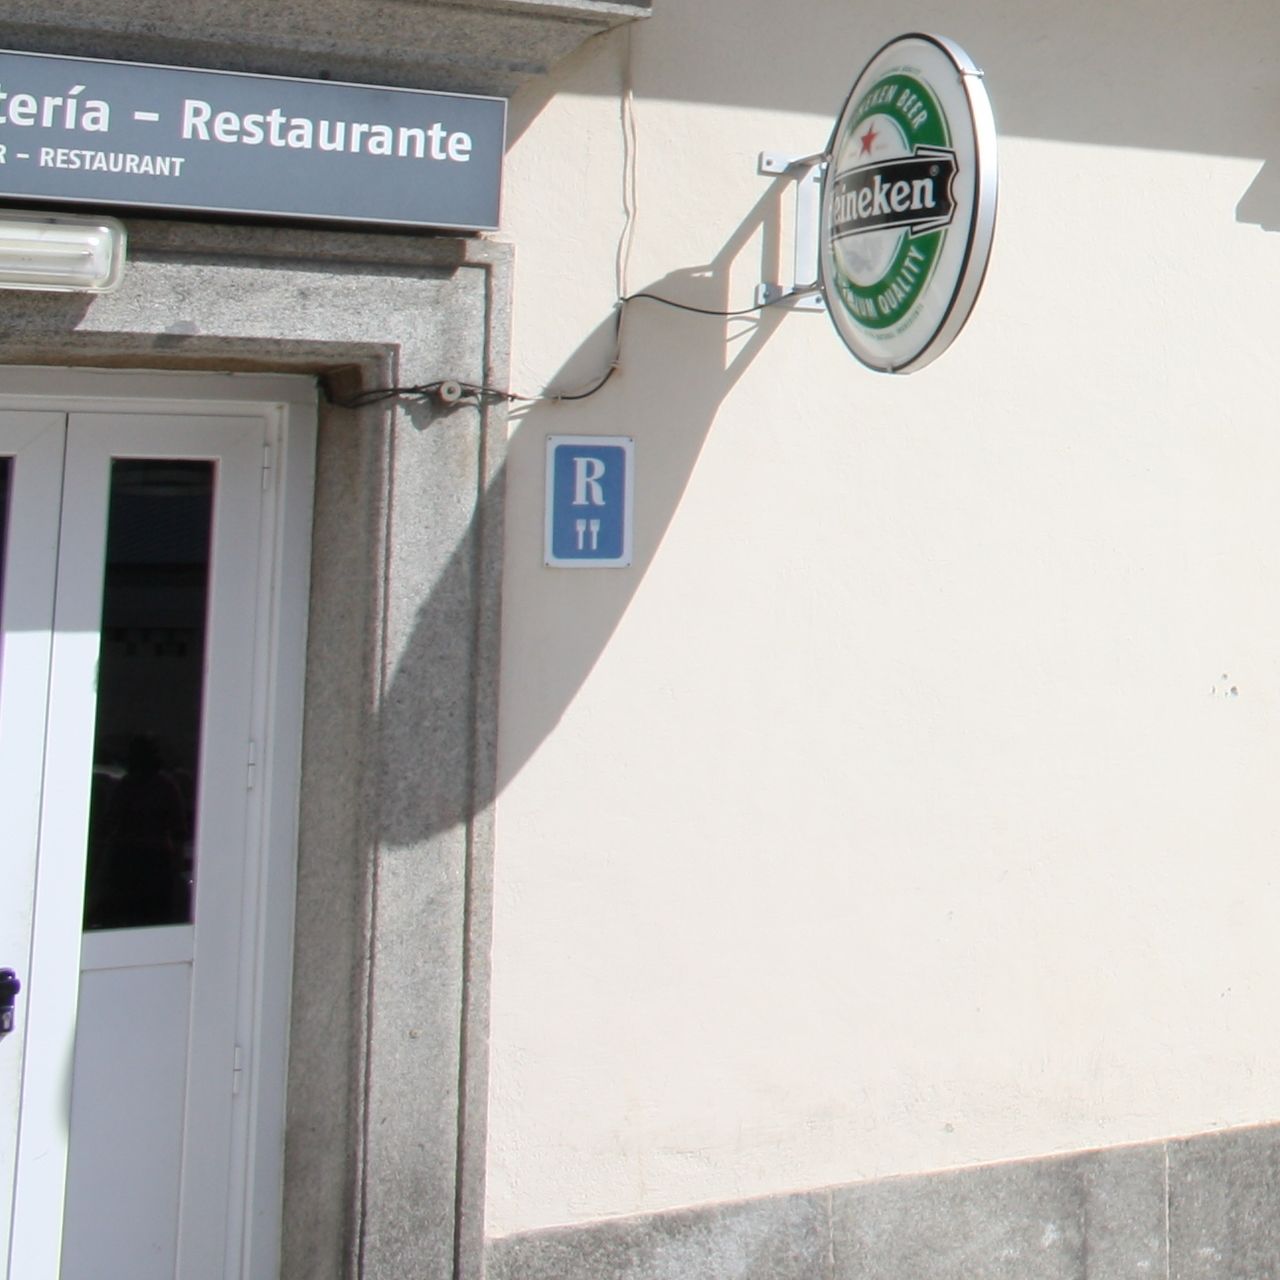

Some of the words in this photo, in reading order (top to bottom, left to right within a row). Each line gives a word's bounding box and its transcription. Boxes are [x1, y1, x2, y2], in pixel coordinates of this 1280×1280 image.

[181, 99, 473, 162] Restaurante
[896, 88, 928, 129] BEER
[39, 147, 185, 177] RESTAURANT
[878, 245, 925, 314] QUALITY
[572, 457, 606, 506] R
